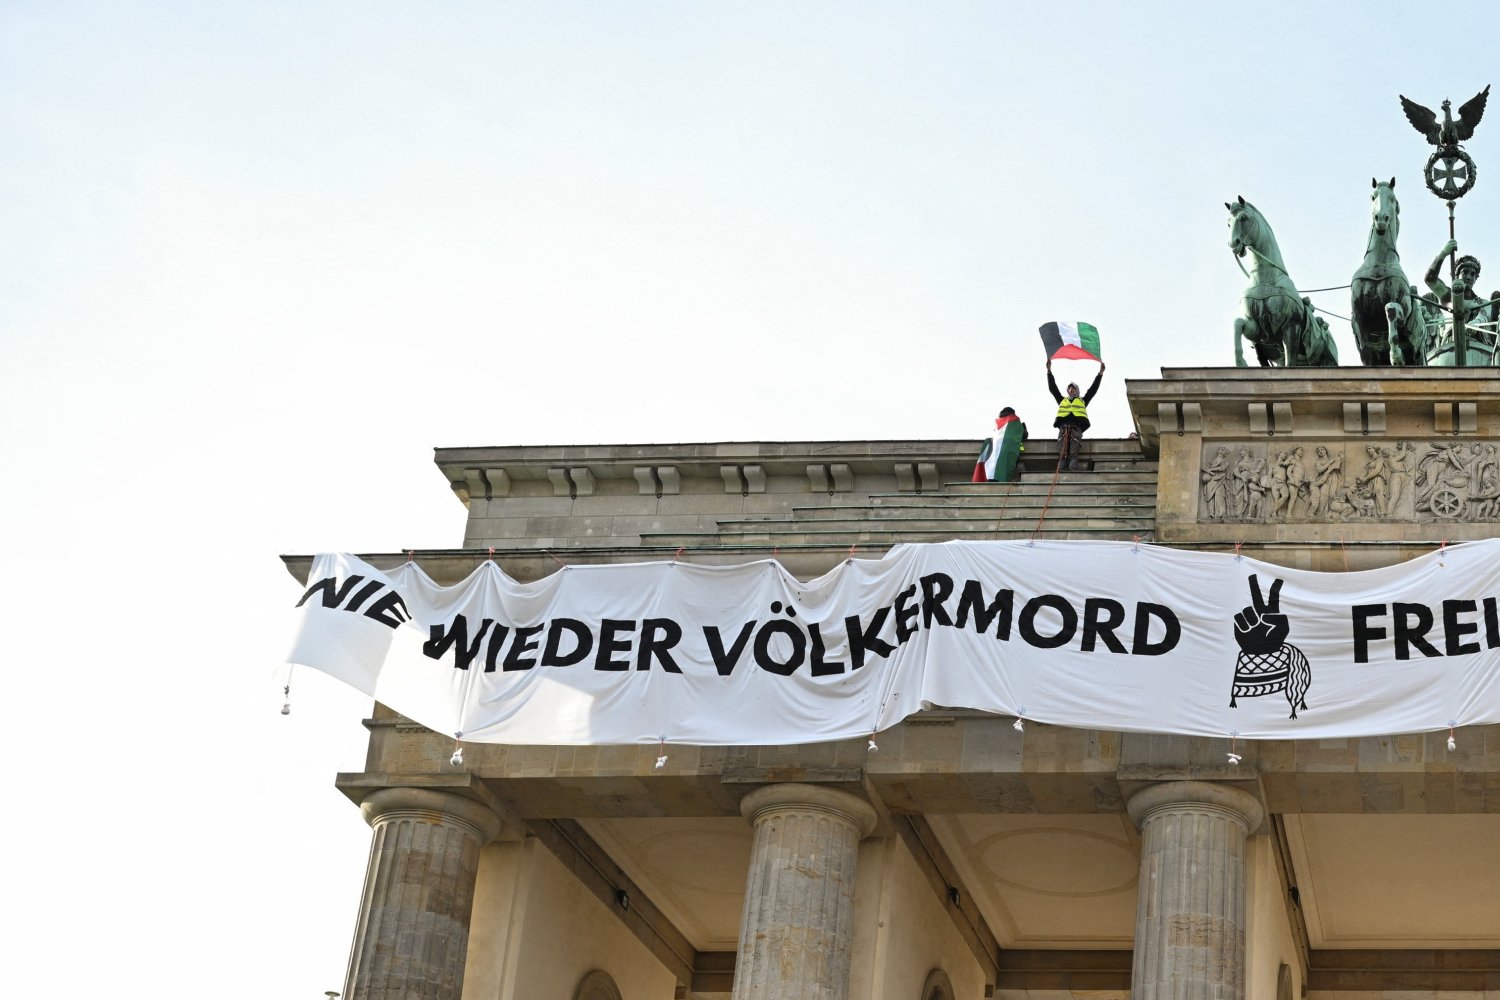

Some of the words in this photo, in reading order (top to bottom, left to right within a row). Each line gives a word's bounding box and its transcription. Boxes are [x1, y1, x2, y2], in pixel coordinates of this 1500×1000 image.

[295, 575, 412, 629] NIE
[423, 613, 682, 673] WIEDER
[702, 573, 1182, 677] VÖLKERMORD
